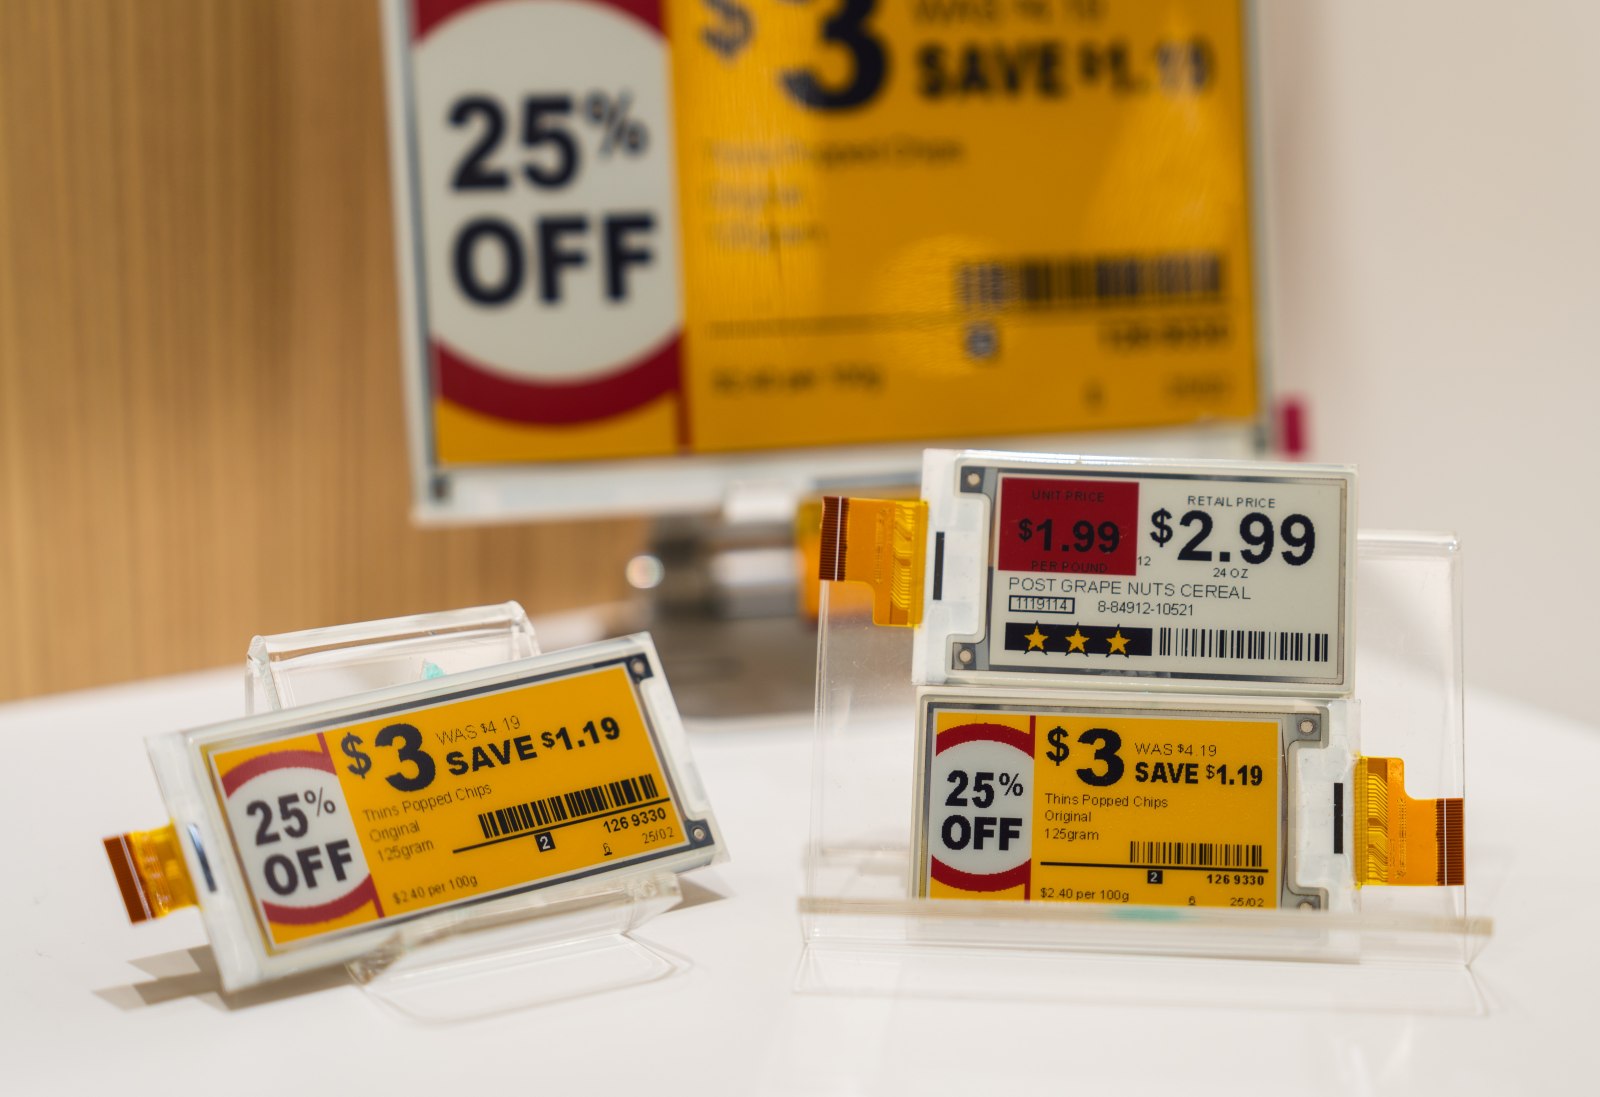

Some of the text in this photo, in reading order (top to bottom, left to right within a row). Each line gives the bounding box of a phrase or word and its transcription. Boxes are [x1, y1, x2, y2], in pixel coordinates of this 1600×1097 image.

[915, 42, 1066, 102] SAVE
[447, 90, 650, 191] 25%
[452, 214, 656, 308] OFF
[1032, 489, 1105, 503] UNIT PRICE
[1187, 495, 1276, 508] RETAIL PRICE
[1018, 518, 1120, 553] $1.99
[1150, 508, 1316, 566] $2.99
[1031, 560, 1108, 573] PER POUND
[1138, 556, 1151, 567] 12
[1213, 567, 1226, 578] 24
[1008, 577, 1252, 600] POST GRAPE NUTS CEREAL
[1016, 597, 1068, 611] 1119114
[1098, 600, 1194, 616] 8-84912-10521
[435, 715, 520, 746] WAS $419
[446, 717, 620, 776] SAVE $1.19
[1134, 742, 1173, 757] WAS
[1135, 762, 1263, 786] SAVE $1.19
[945, 770, 1024, 809] 25%
[1045, 793, 1168, 809] Thins Popped Chips
[362, 783, 493, 823] Thins Popped Chips
[246, 787, 336, 846] 25%
[603, 807, 666, 833] 126 9330
[1045, 809, 1092, 823] Original
[369, 820, 420, 843] Original
[539, 835, 551, 850] 2
[641, 826, 675, 844] 25/02
[941, 814, 1023, 851] OFF
[1044, 828, 1100, 842] 125gram
[377, 838, 434, 862] 125gram
[264, 838, 353, 896] OFF
[392, 875, 478, 904] $240 per 100g
[1206, 873, 1265, 886] 126 9330
[1076, 889, 1096, 901] per
[1100, 889, 1130, 903] 100g
[1230, 897, 1264, 908] 25/02
